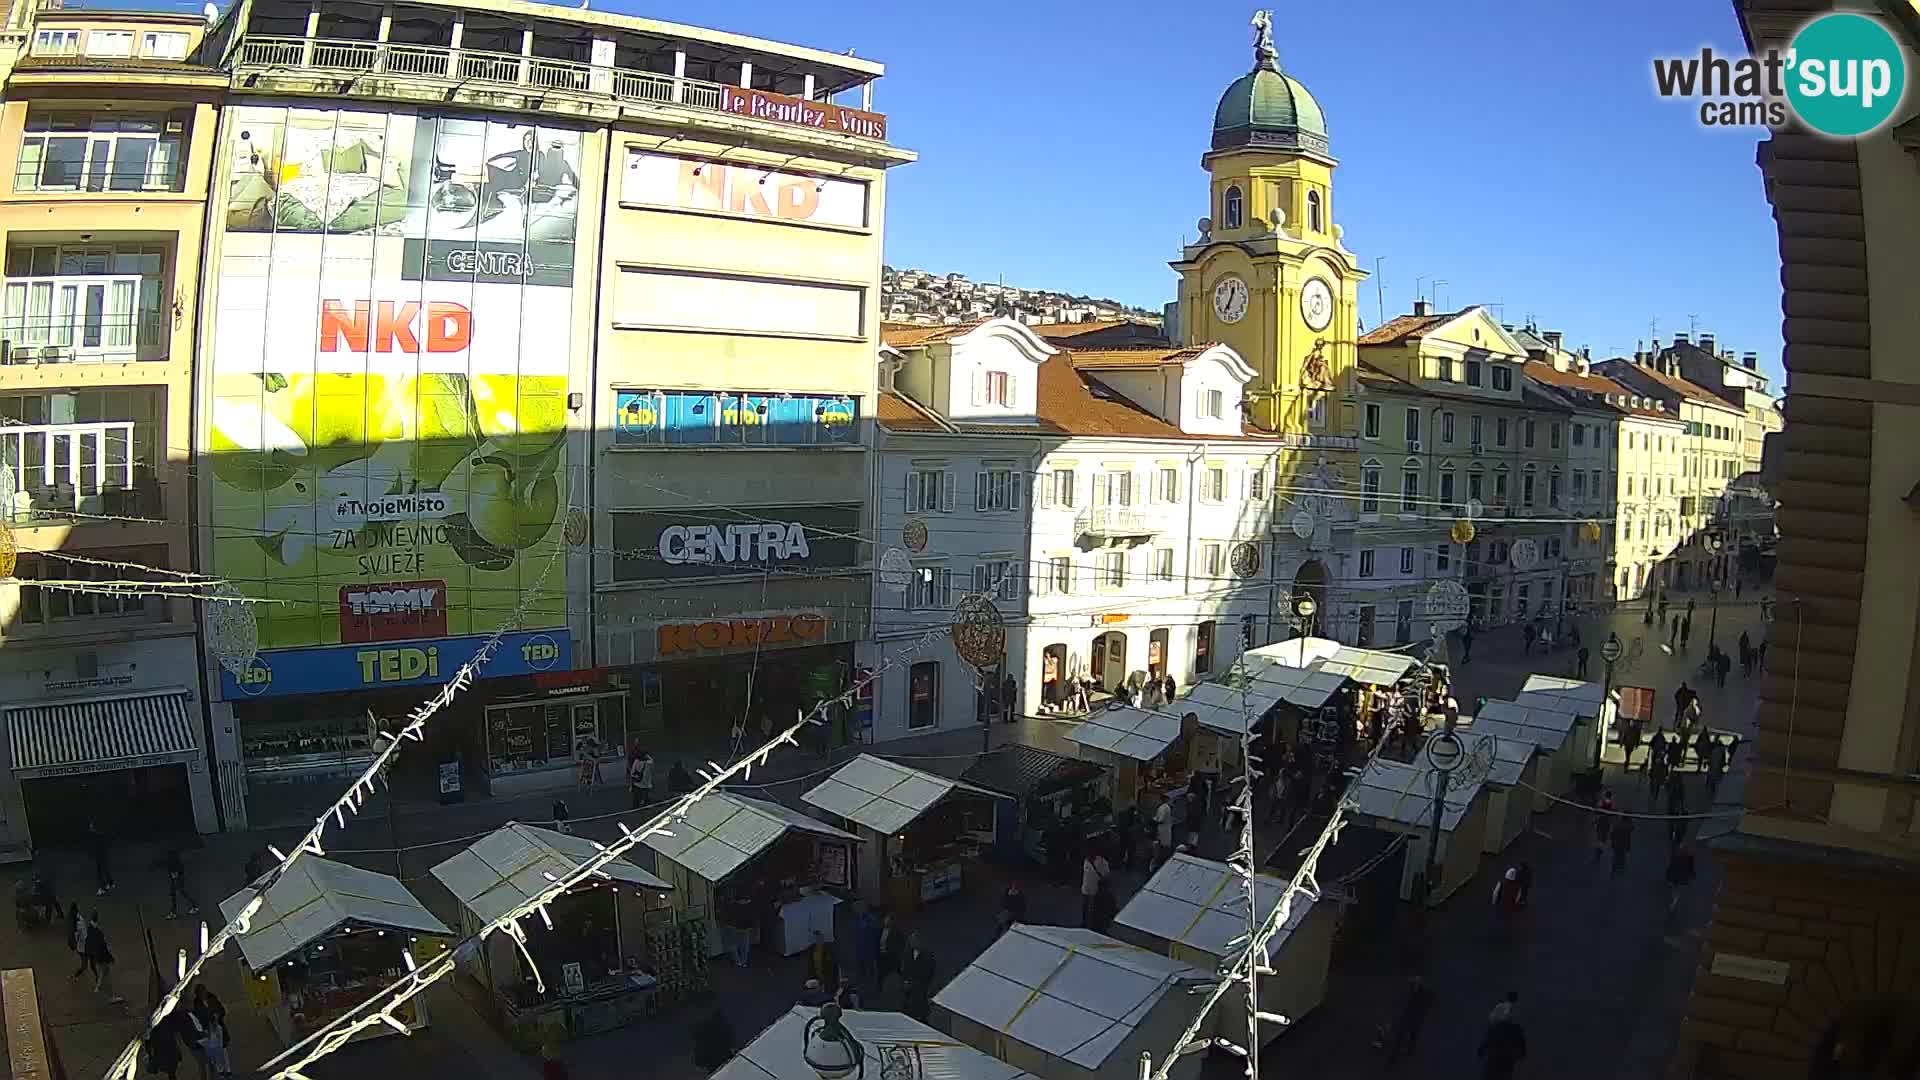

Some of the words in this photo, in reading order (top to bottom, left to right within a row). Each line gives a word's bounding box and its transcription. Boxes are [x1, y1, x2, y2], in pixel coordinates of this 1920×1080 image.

[721, 87, 745, 113] Le
[679, 161, 819, 221] NKD
[446, 250, 534, 277] CENTRA
[319, 298, 474, 353] NKD
[337, 497, 445, 517] #TvojeMisto
[332, 530, 357, 549] ZA
[367, 524, 448, 548] DNEVNO
[658, 522, 810, 565] CENTRA
[358, 548, 426, 575] SVJEŽE
[357, 646, 438, 683] TEDi
[522, 643, 559, 661] TEDi
